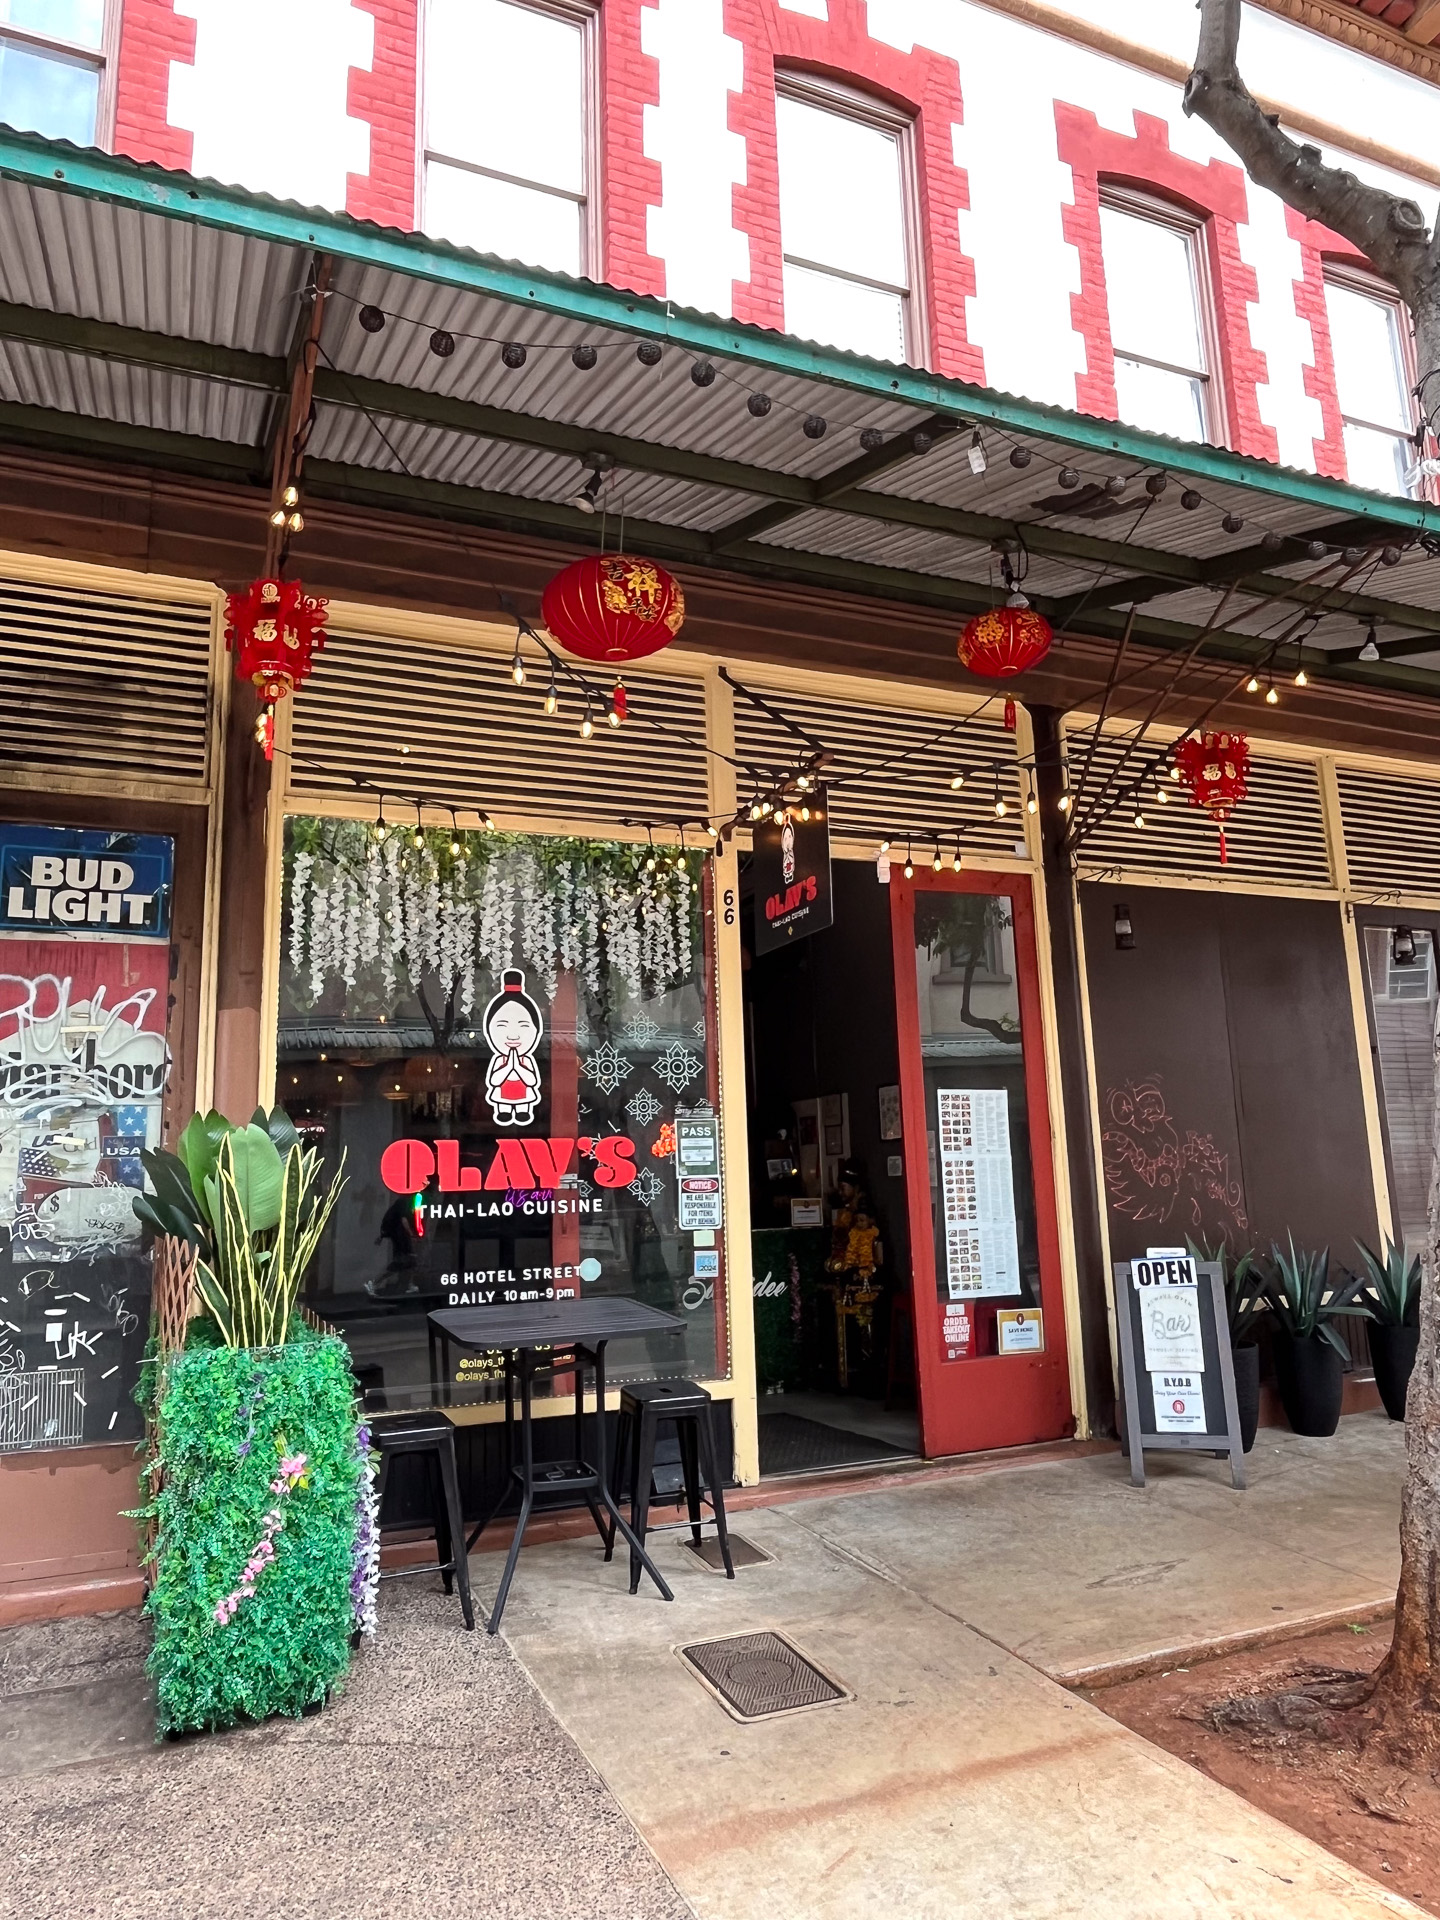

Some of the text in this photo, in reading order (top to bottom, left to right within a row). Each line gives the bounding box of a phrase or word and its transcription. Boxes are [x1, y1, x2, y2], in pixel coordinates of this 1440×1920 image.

[31, 855, 135, 892] BUD
[7, 886, 153, 925] LIGHT
[681, 1126, 711, 1137] PASS
[106, 1146, 141, 1157] USA
[381, 1136, 637, 1194] OLAY'S
[688, 1181, 712, 1190] NOTICE
[418, 1198, 603, 1219] THAI-LAO CUISINE
[440, 1265, 580, 1286] 66 HOTEL STREET
[1137, 1260, 1193, 1287] OPEN
[449, 1290, 496, 1306] DAILY
[943, 1316, 969, 1326] ORDER
[942, 1325, 971, 1335] TAKEOUT
[944, 1333, 970, 1343] ONLINE
